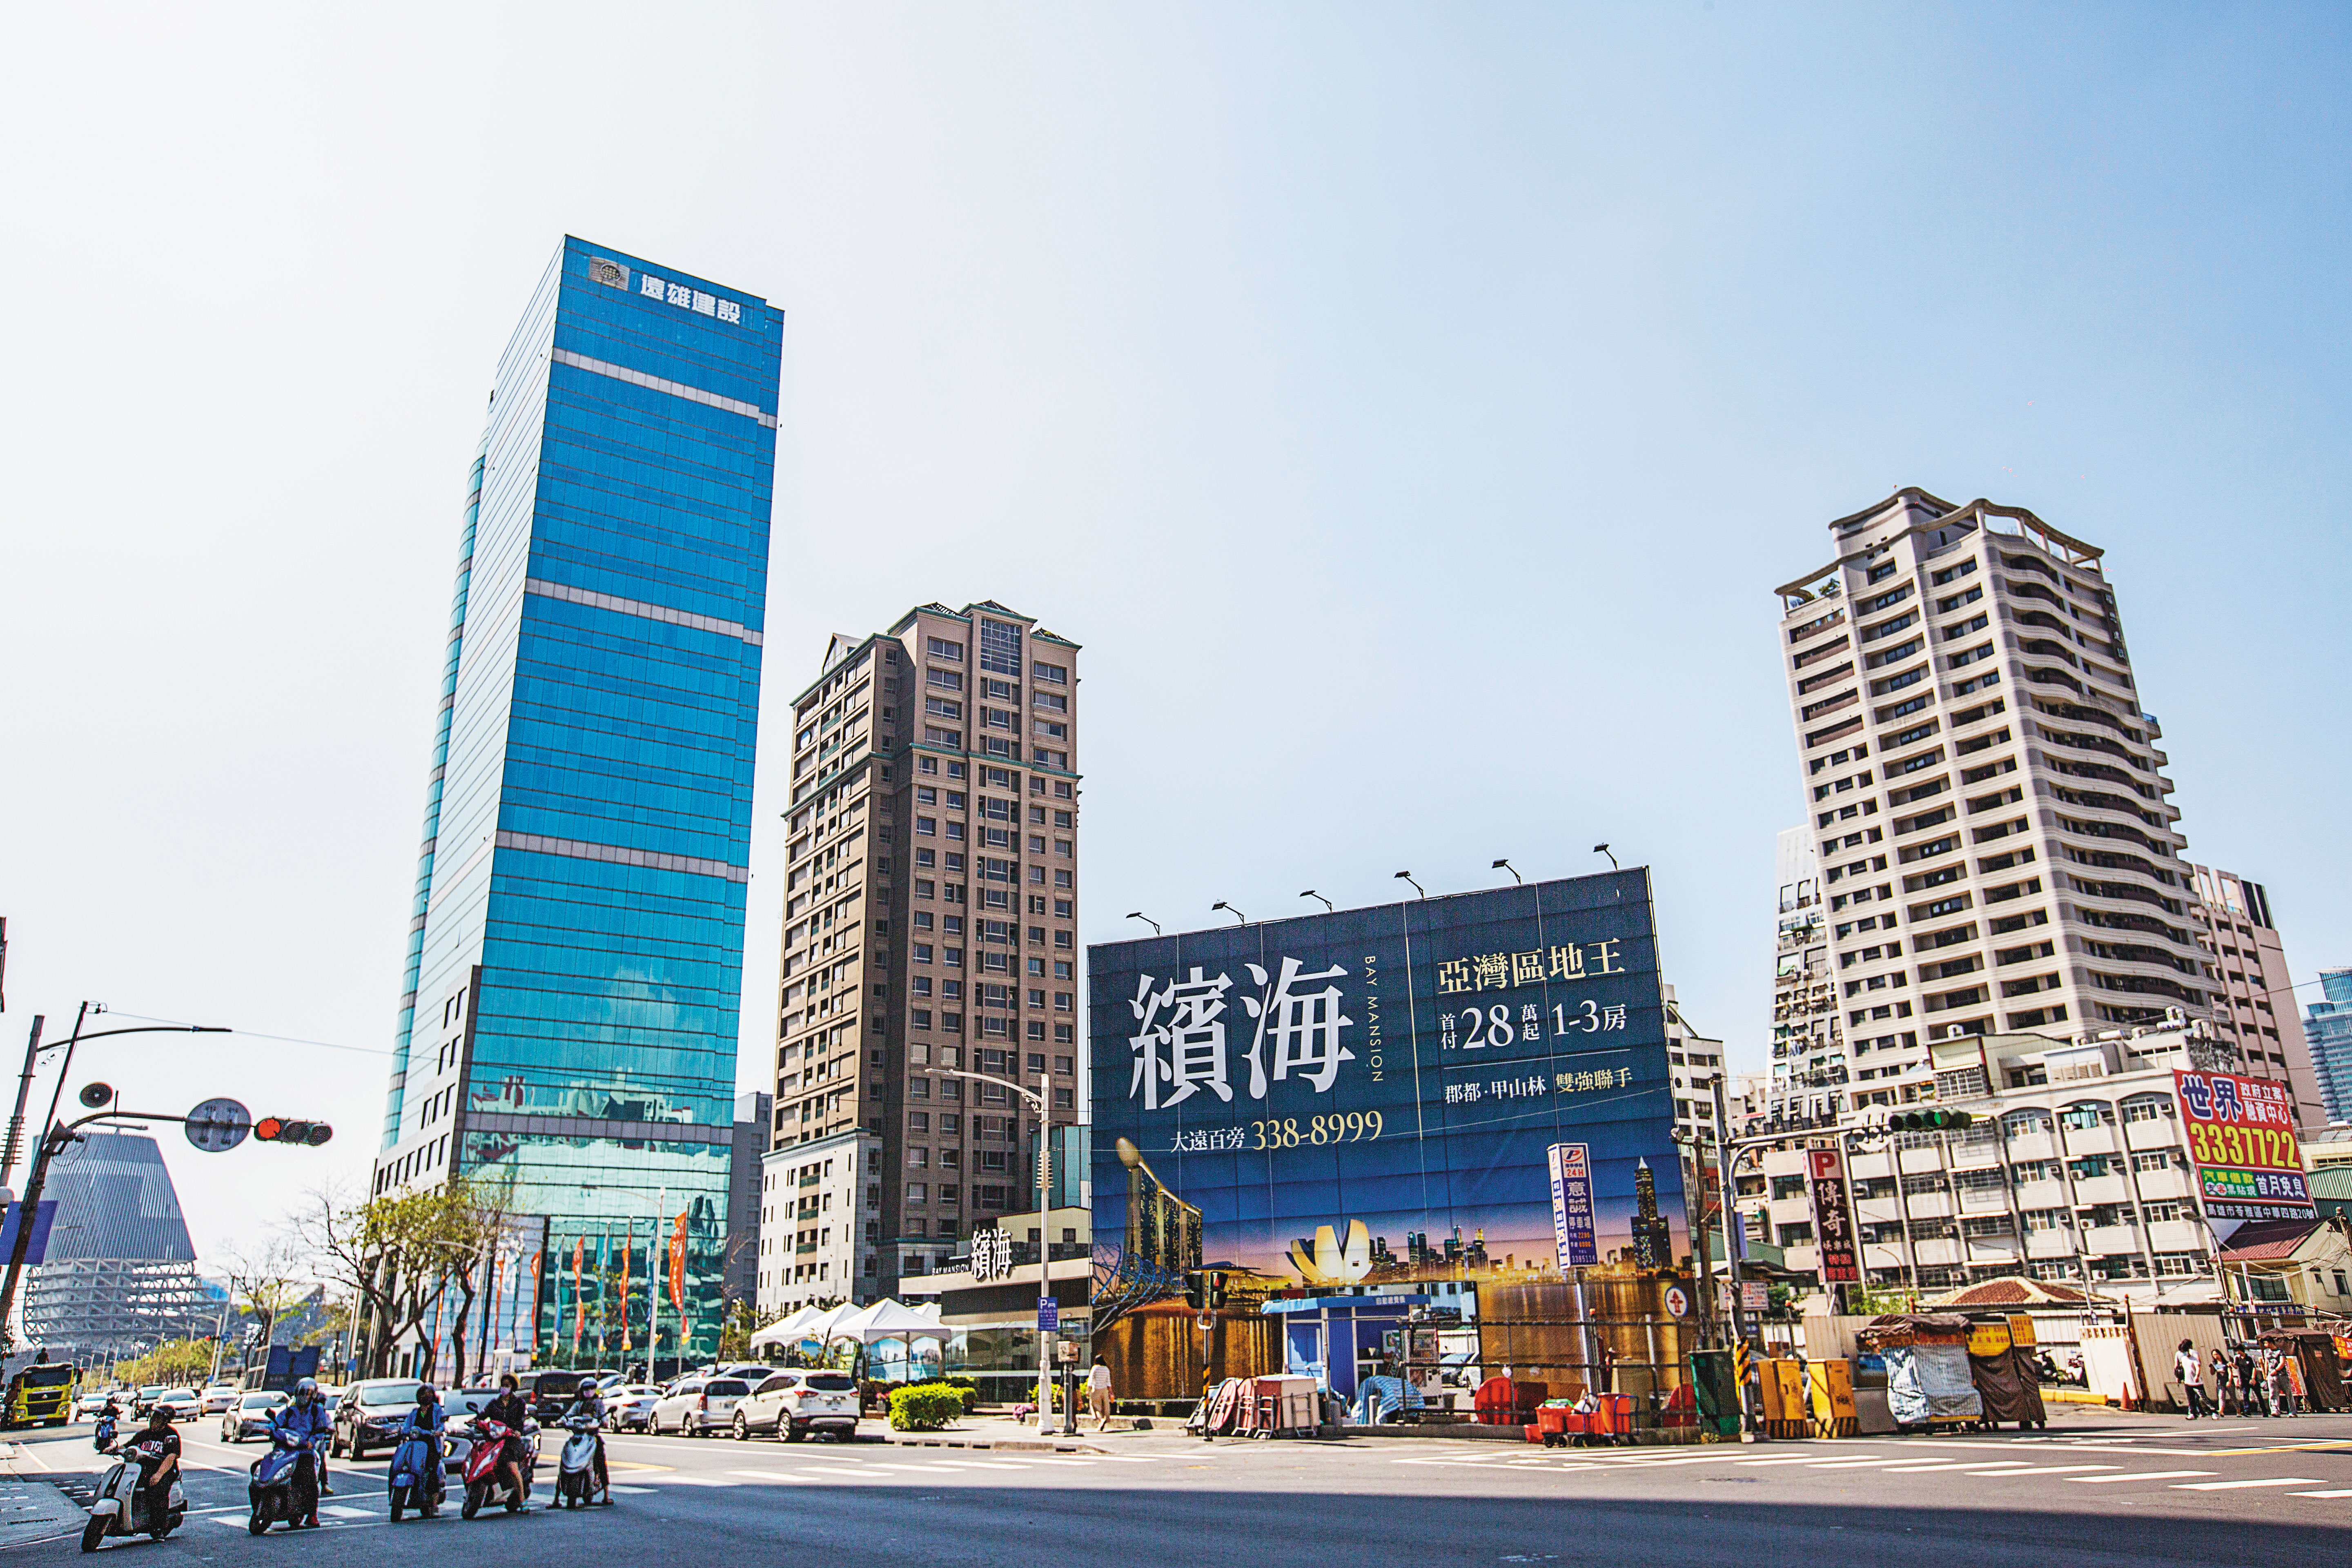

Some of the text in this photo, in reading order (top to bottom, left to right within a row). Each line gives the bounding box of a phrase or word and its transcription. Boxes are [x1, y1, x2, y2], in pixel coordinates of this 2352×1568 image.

[641, 274, 741, 325] 遠雄建設
[1437, 938, 1626, 994] 亞灣區地王
[1128, 956, 1355, 1110] 繽海
[1365, 956, 1383, 1082] BAY MANSION
[1441, 1013, 1458, 1050] 首付
[1461, 1004, 1514, 1049] 28
[1520, 1004, 1540, 1042] 萬起
[1556, 1067, 1633, 1094] 雙強聯手
[2180, 1074, 2243, 1123] 世界
[2239, 1082, 2283, 1101] 政府立案
[1170, 1111, 1383, 1153] 大遠百旁 338-8999
[2244, 1100, 2288, 1125] 融資中心
[1814, 1152, 1836, 1177] P
[2189, 1122, 2300, 1168] 3337722
[1817, 1180, 1846, 1237] 傳奇
[2255, 1174, 2305, 1198] 首月免息
[971, 1227, 1012, 1279] 繽海
[1040, 1299, 1048, 1310] P
